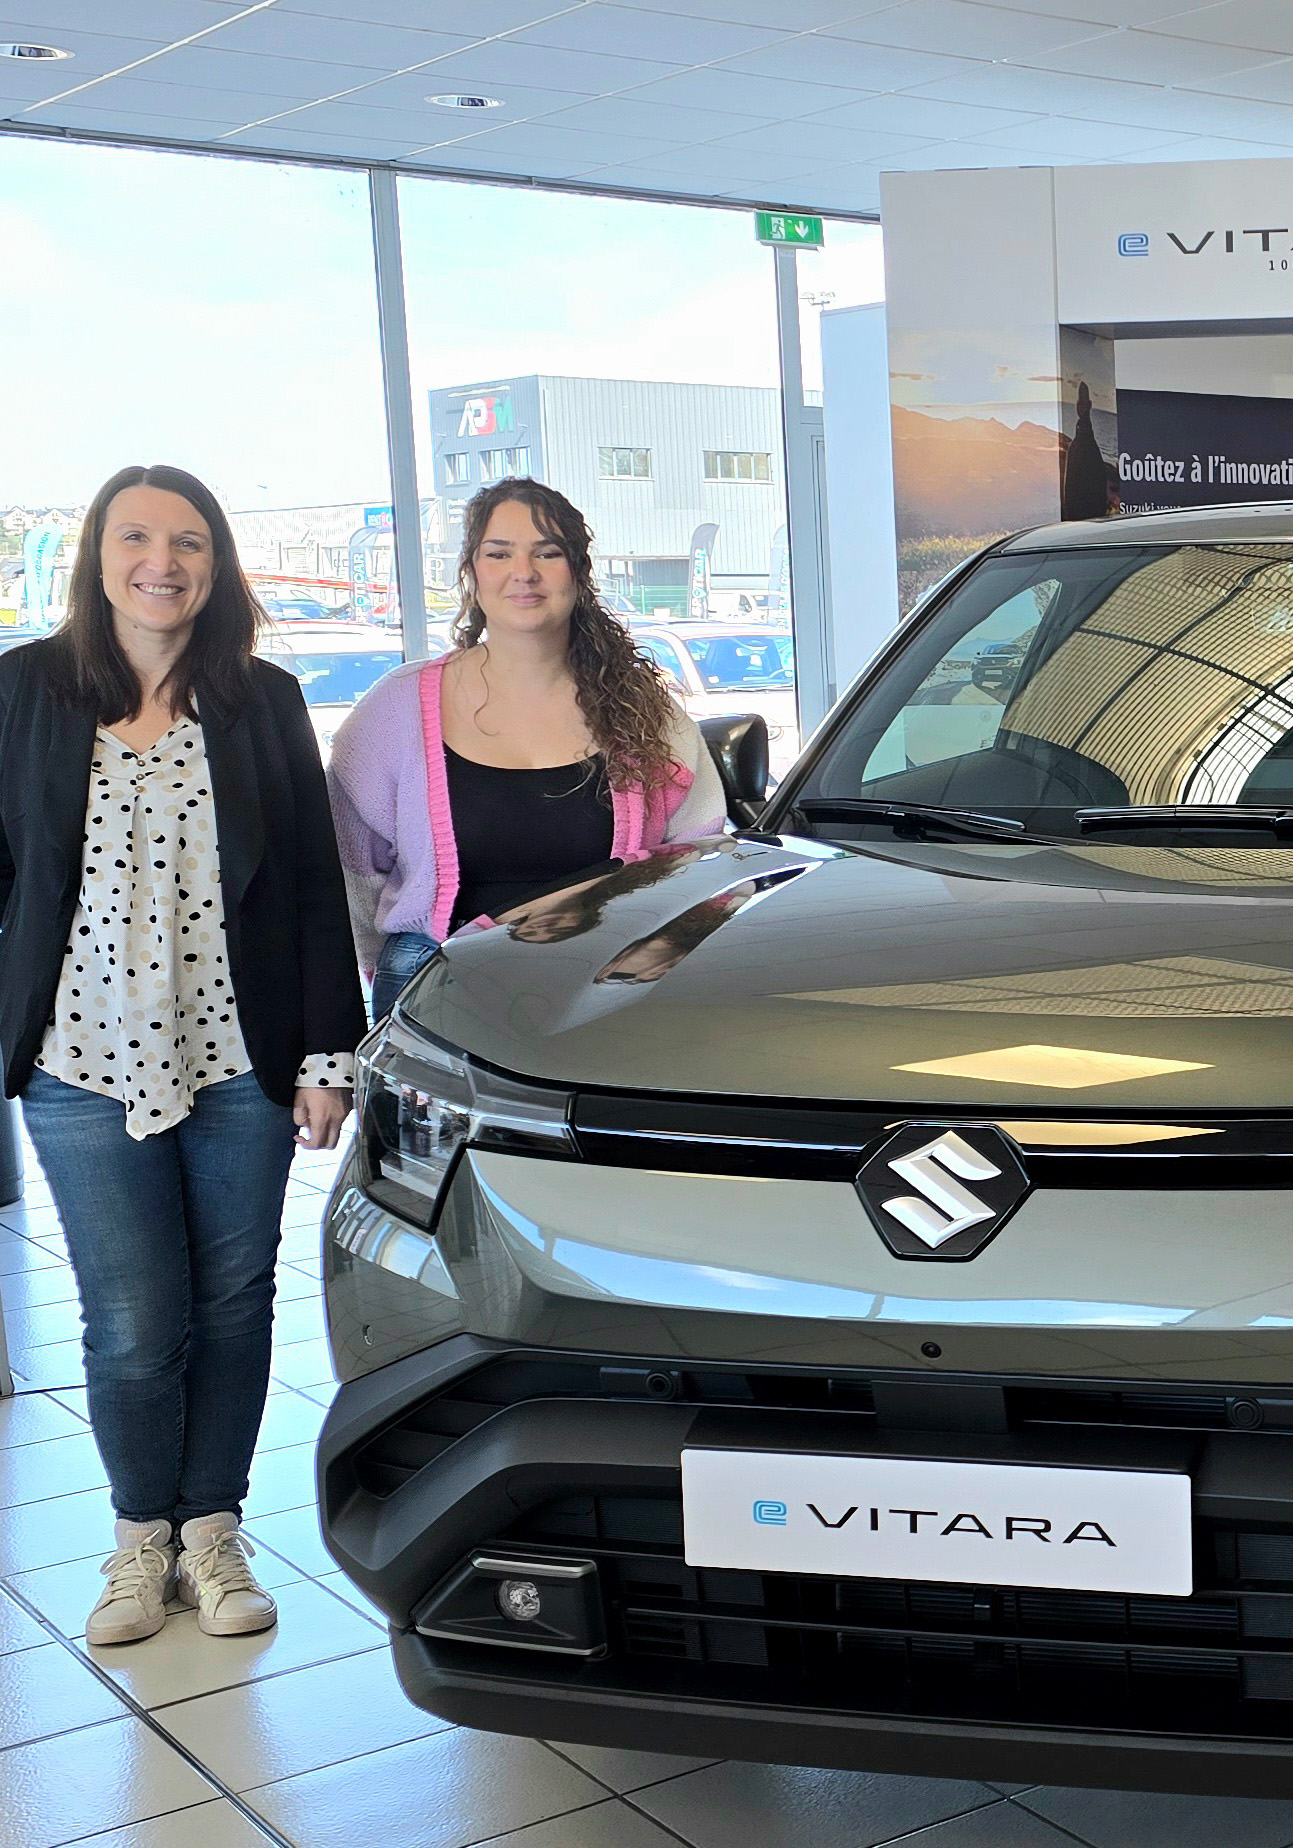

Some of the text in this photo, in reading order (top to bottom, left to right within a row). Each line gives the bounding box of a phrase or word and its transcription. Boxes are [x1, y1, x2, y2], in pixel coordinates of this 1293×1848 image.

[1118, 452, 1185, 483] Goûtez
[1190, 455, 1202, 483] à
[1119, 502, 1155, 515] Suzuki
[806, 1503, 1118, 1548] VITARA
